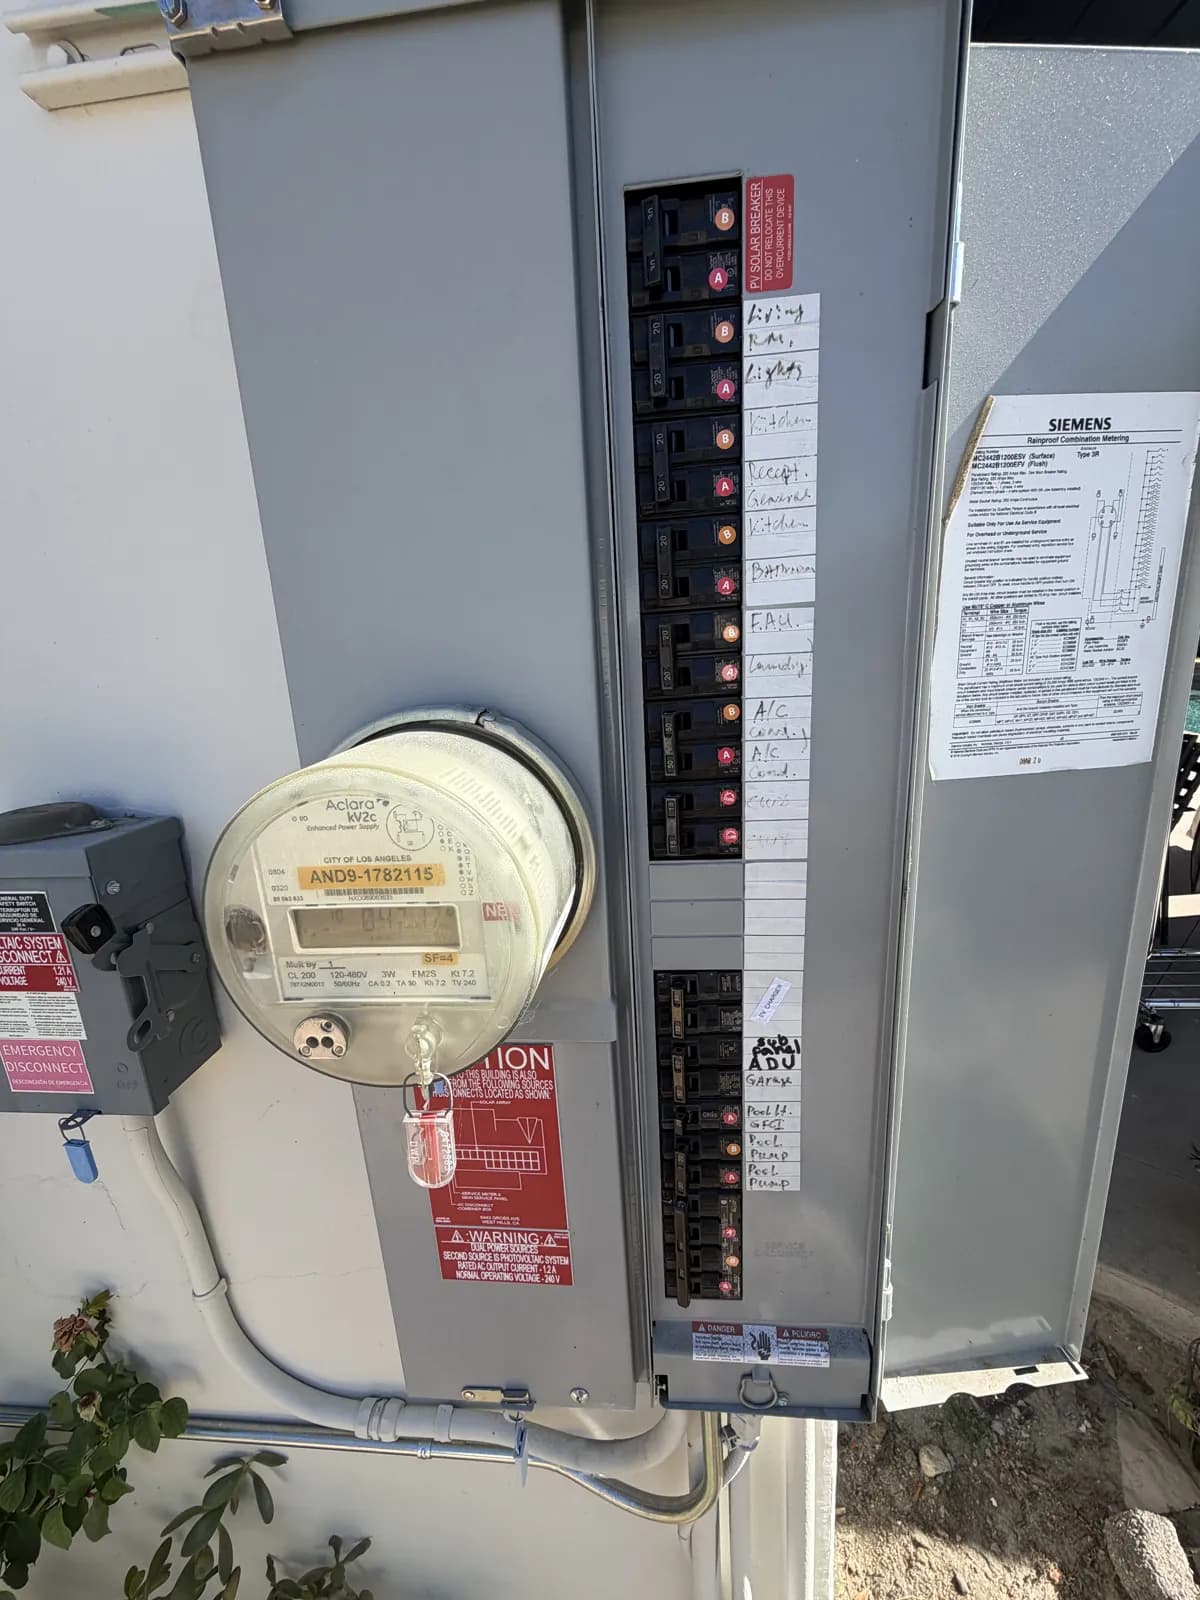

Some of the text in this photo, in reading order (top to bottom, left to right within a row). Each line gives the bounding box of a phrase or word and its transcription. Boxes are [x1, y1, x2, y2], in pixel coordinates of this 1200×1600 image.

[750, 182, 760, 289] PV SOLAR BREAKER
[764, 188, 774, 281] DO NOT RELOCATE THIS
[776, 188, 785, 279] OVERCURRENT DEVICE
[1048, 417, 1112, 432] SIEMENS
[1027, 436, 1059, 445] Rainproof
[1102, 434, 1129, 443] Metering
[753, 700, 788, 723] A/C
[326, 798, 374, 811] Aclara
[347, 811, 377, 822] kV2c
[310, 867, 434, 883] AND9-1782115
[24, 937, 62, 950] SYSTEM
[424, 953, 453, 963] SF=4
[67, 966, 72, 975] A
[2, 1045, 77, 1057] EMERGENCY
[6, 1061, 84, 1074] DISCONNECT
[749, 1054, 795, 1070] ADU
[466, 1069, 480, 1079] THIS
[481, 1069, 511, 1080] BUILDING
[512, 1070, 519, 1080] IS
[520, 1070, 536, 1080] ALSO
[470, 1079, 553, 1090] THE FOLLOWING SOURCES
[485, 1088, 514, 1098] LOCATED
[515, 1089, 524, 1099] AS
[471, 1242, 538, 1254] DUAL POWER SOURCES
[443, 1251, 468, 1260] SECOND
[468, 1252, 492, 1261] SOURCE
[501, 1253, 544, 1264] PHOTOVOLTAIC
[545, 1255, 569, 1265] SYSTEM
[458, 1261, 476, 1270] RATED
[478, 1262, 486, 1270] AC
[487, 1262, 510, 1272] OUTPUT
[510, 1263, 538, 1272] CURRENT
[456, 1270, 480, 1279] NORMAL
[481, 1271, 513, 1280] OPERATING
[514, 1273, 541, 1282] VOLTAGE
[708, 1324, 736, 1333] DANGER
